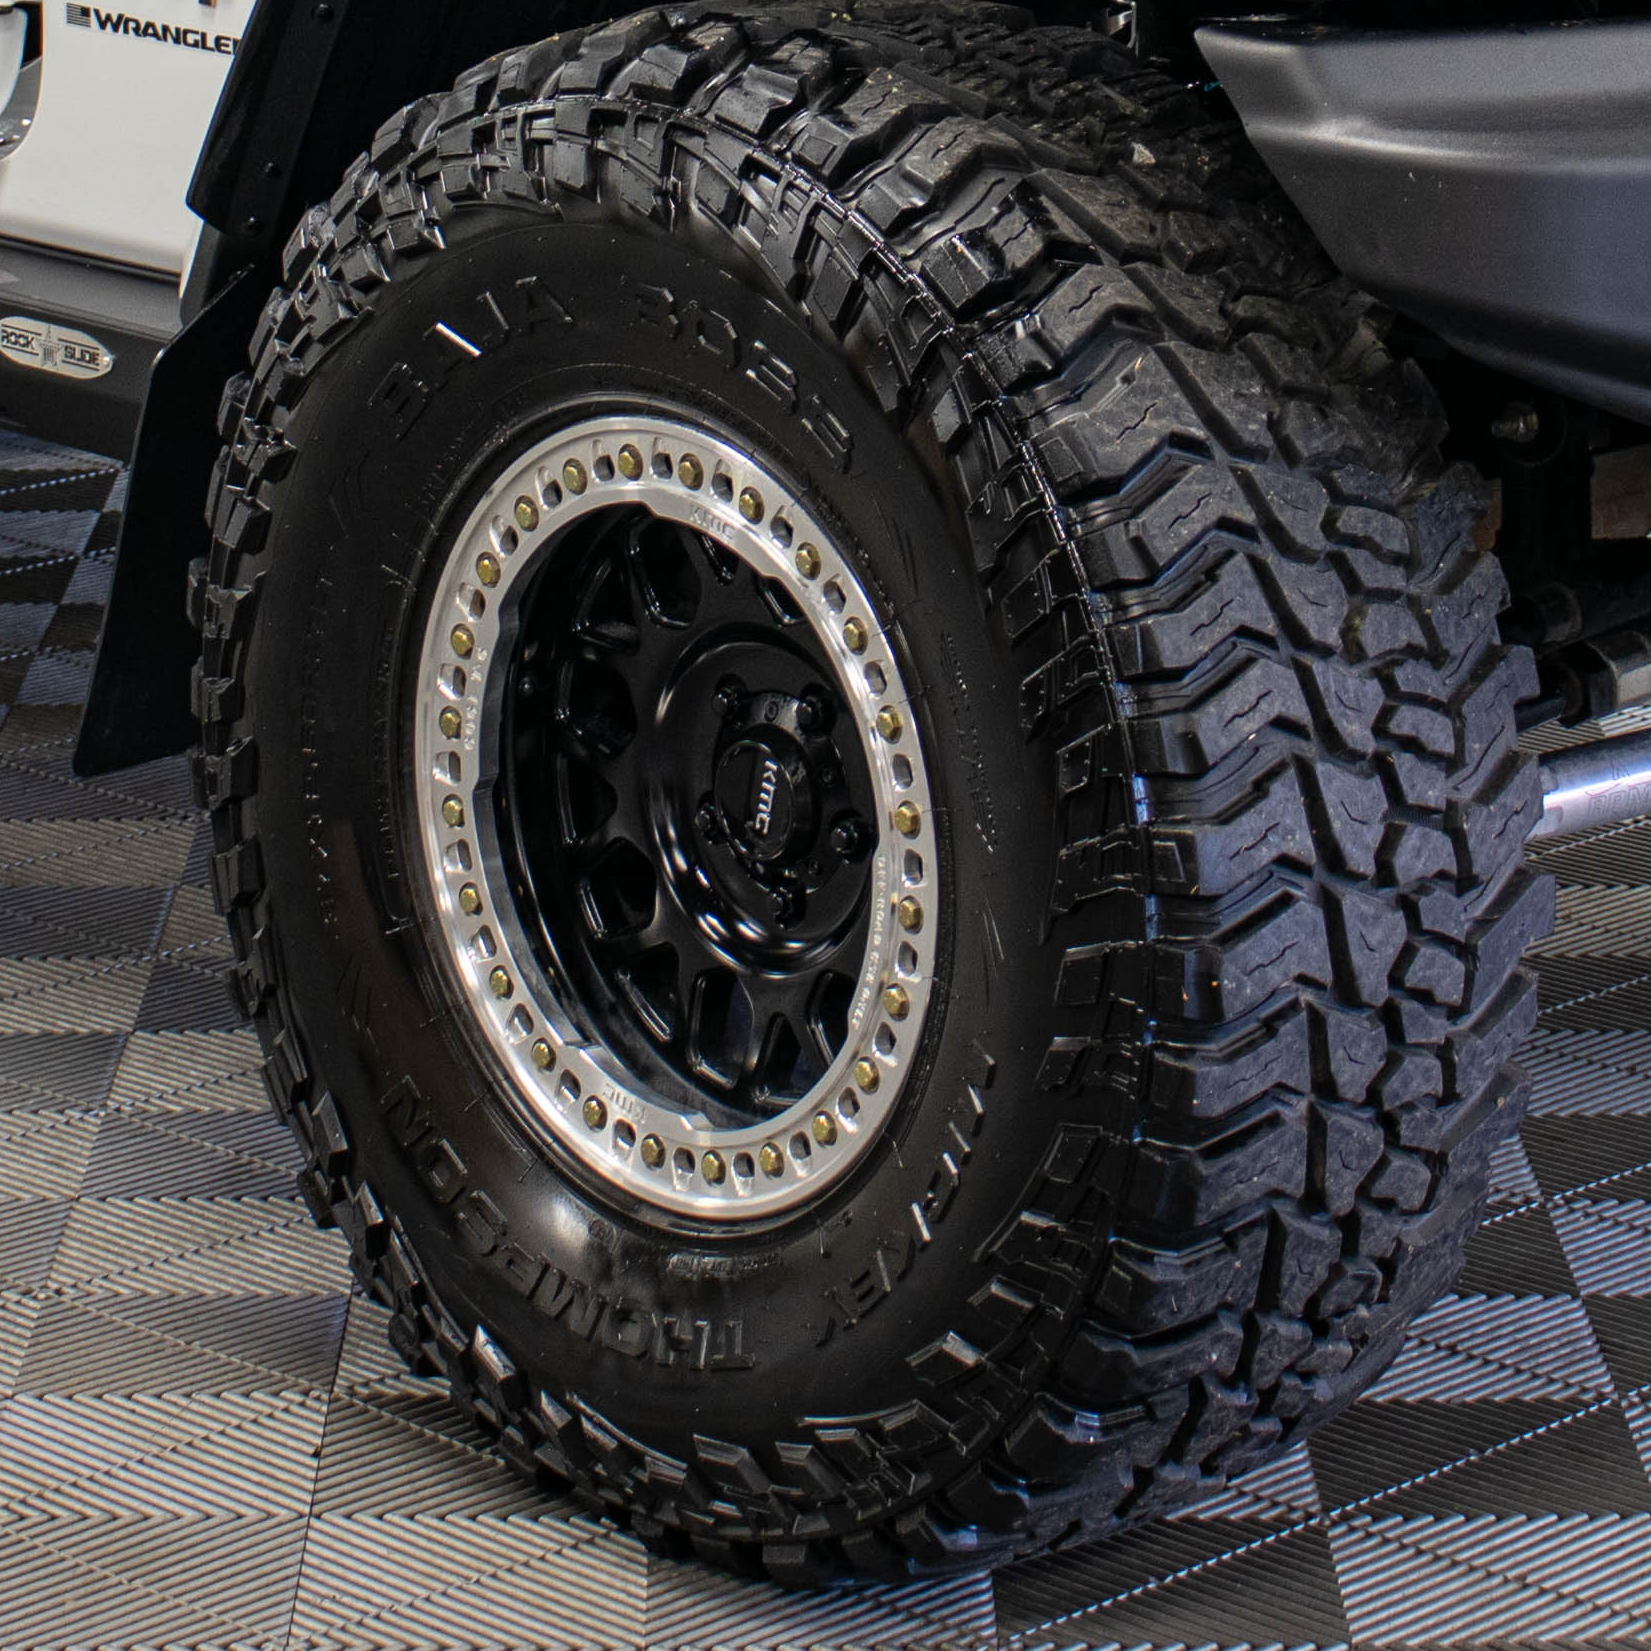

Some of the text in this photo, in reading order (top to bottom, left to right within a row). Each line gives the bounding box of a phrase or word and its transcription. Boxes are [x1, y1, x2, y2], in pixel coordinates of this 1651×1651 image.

[92, 7, 243, 56] WRANGLE
[0, 329, 101, 367] ROCK SLIDE
[365, 274, 577, 441] BAJA
[379, 1074, 757, 1373] THOMPSON
